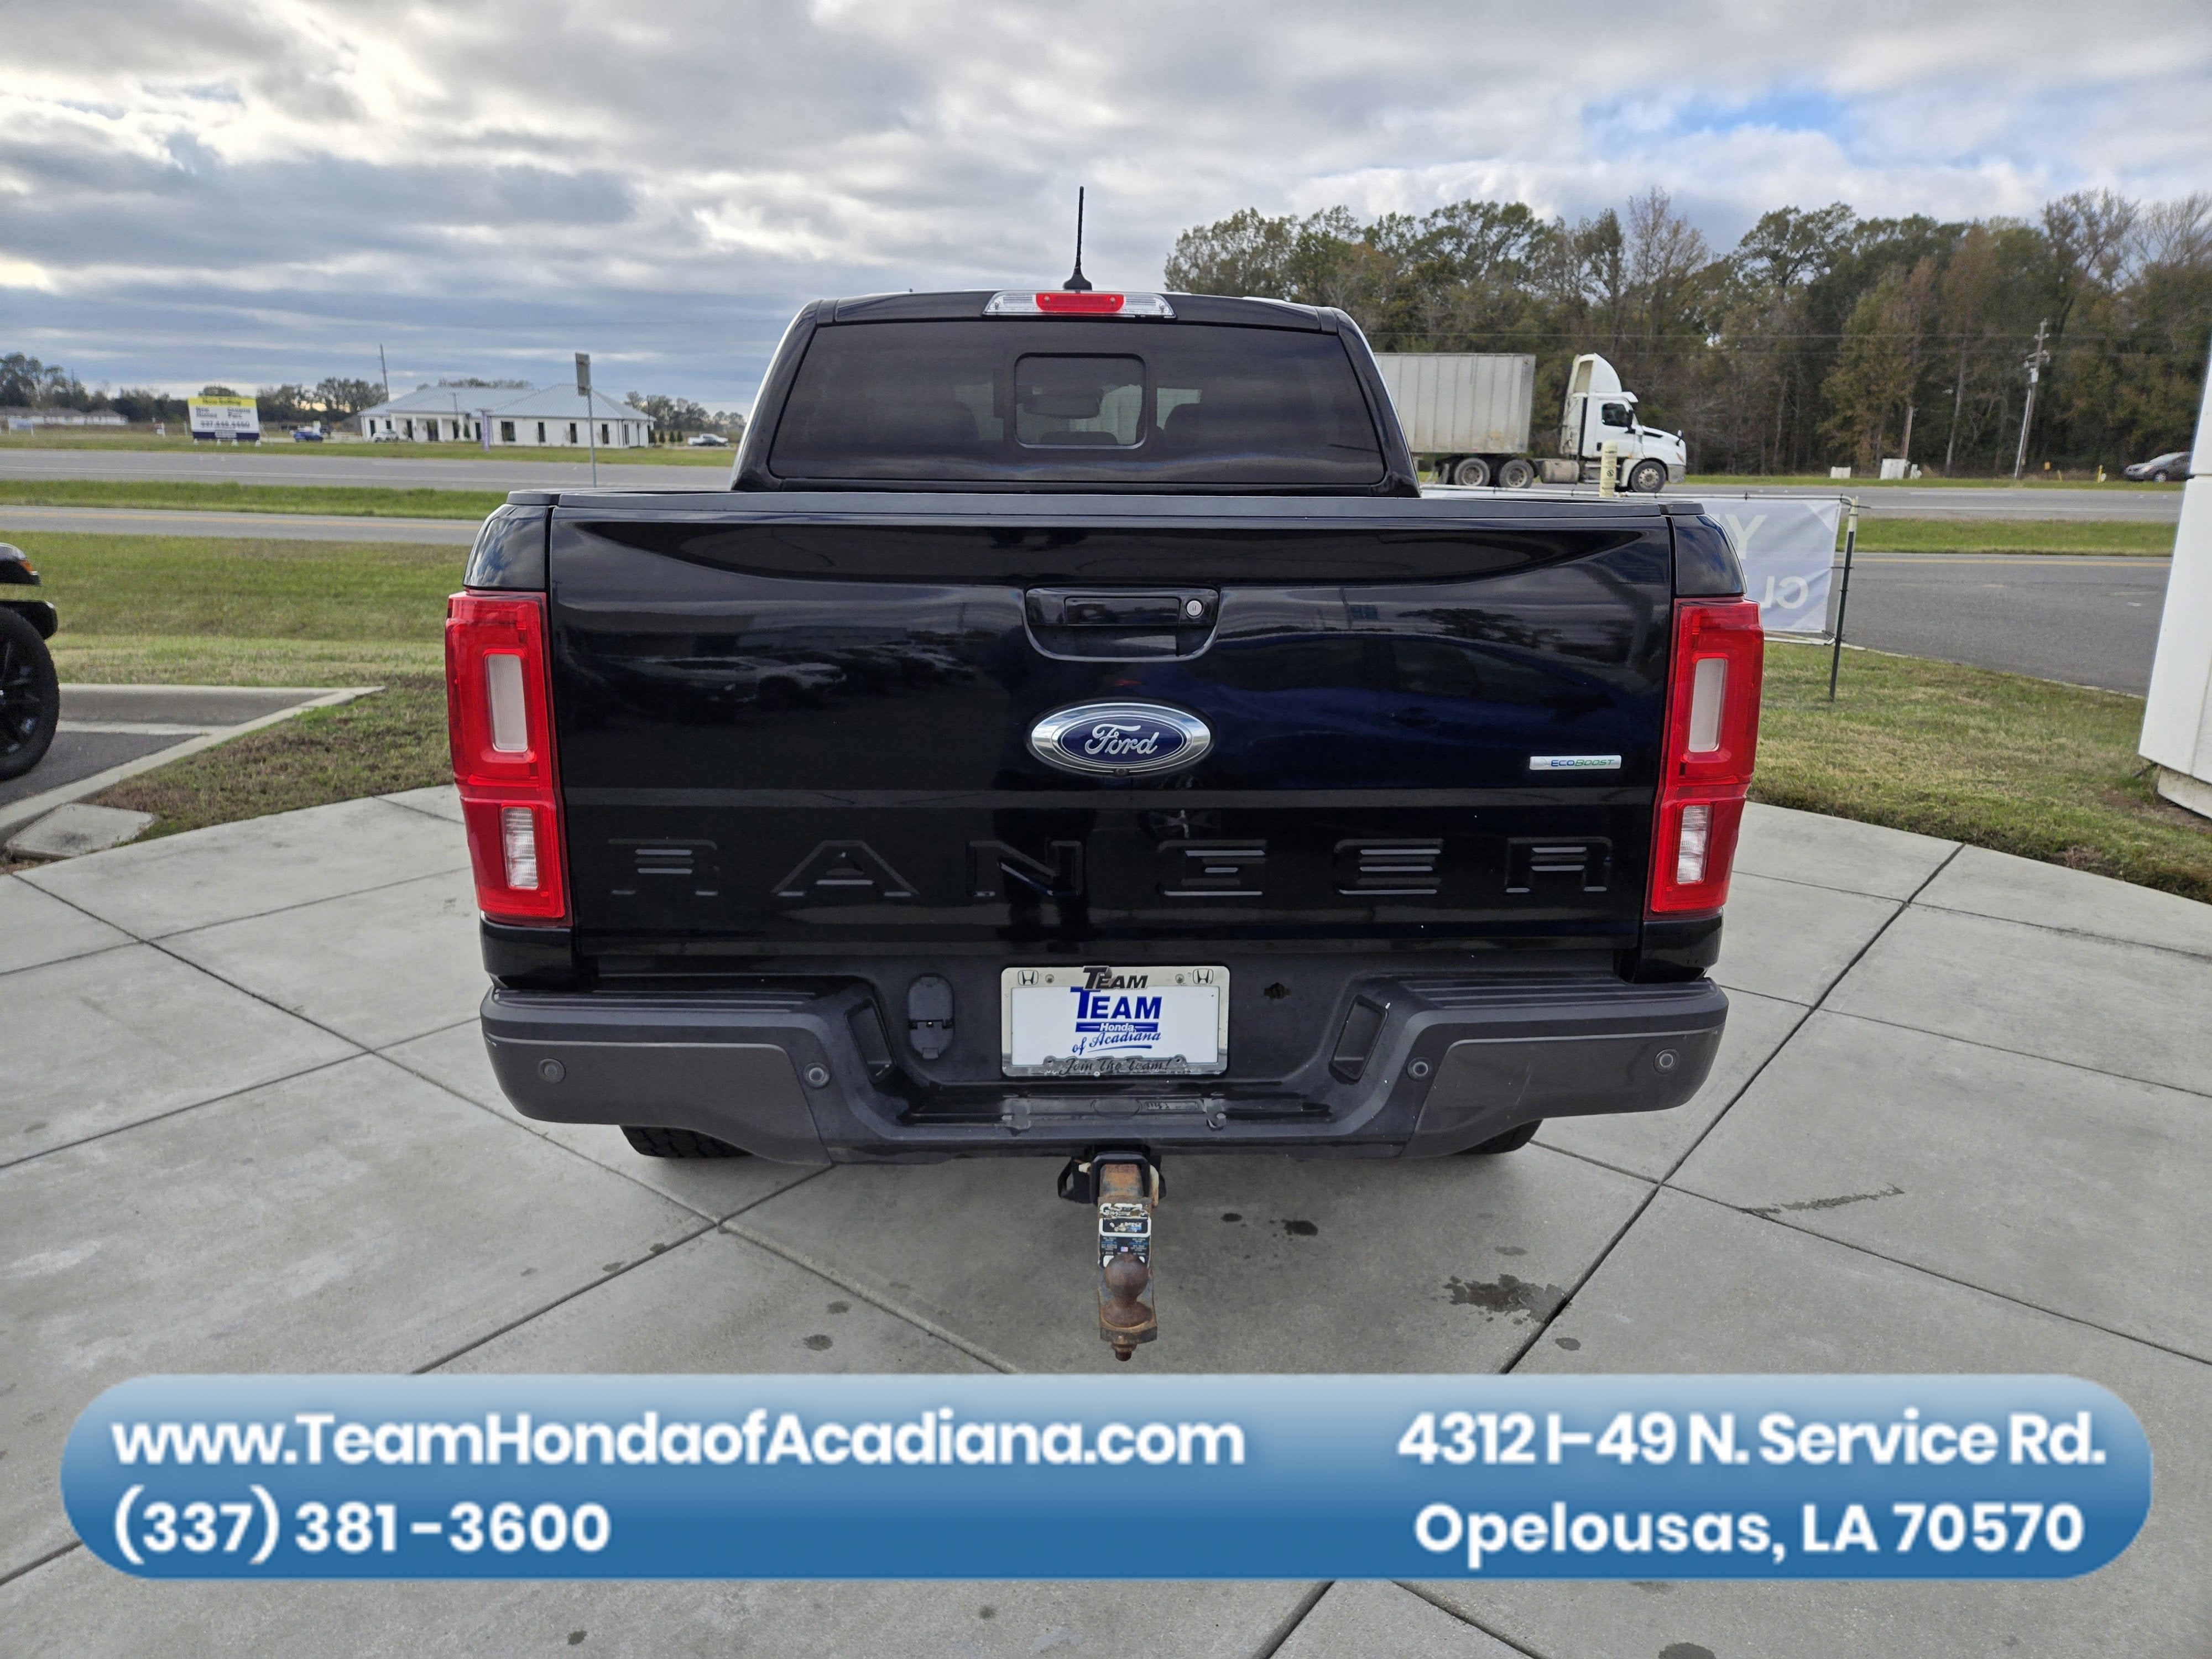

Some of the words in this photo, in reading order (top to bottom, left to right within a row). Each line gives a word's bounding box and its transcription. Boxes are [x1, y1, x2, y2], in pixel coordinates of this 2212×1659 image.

[1084, 723, 1160, 754] Ford
[607, 837, 1614, 897] RANGER
[1070, 987, 1162, 1019] TEAM
[1099, 1022, 1134, 1032] Honda
[1072, 1036, 1087, 1056] of
[1089, 1030, 1161, 1048] Acadiana
[1058, 1057, 1093, 1076] Join
